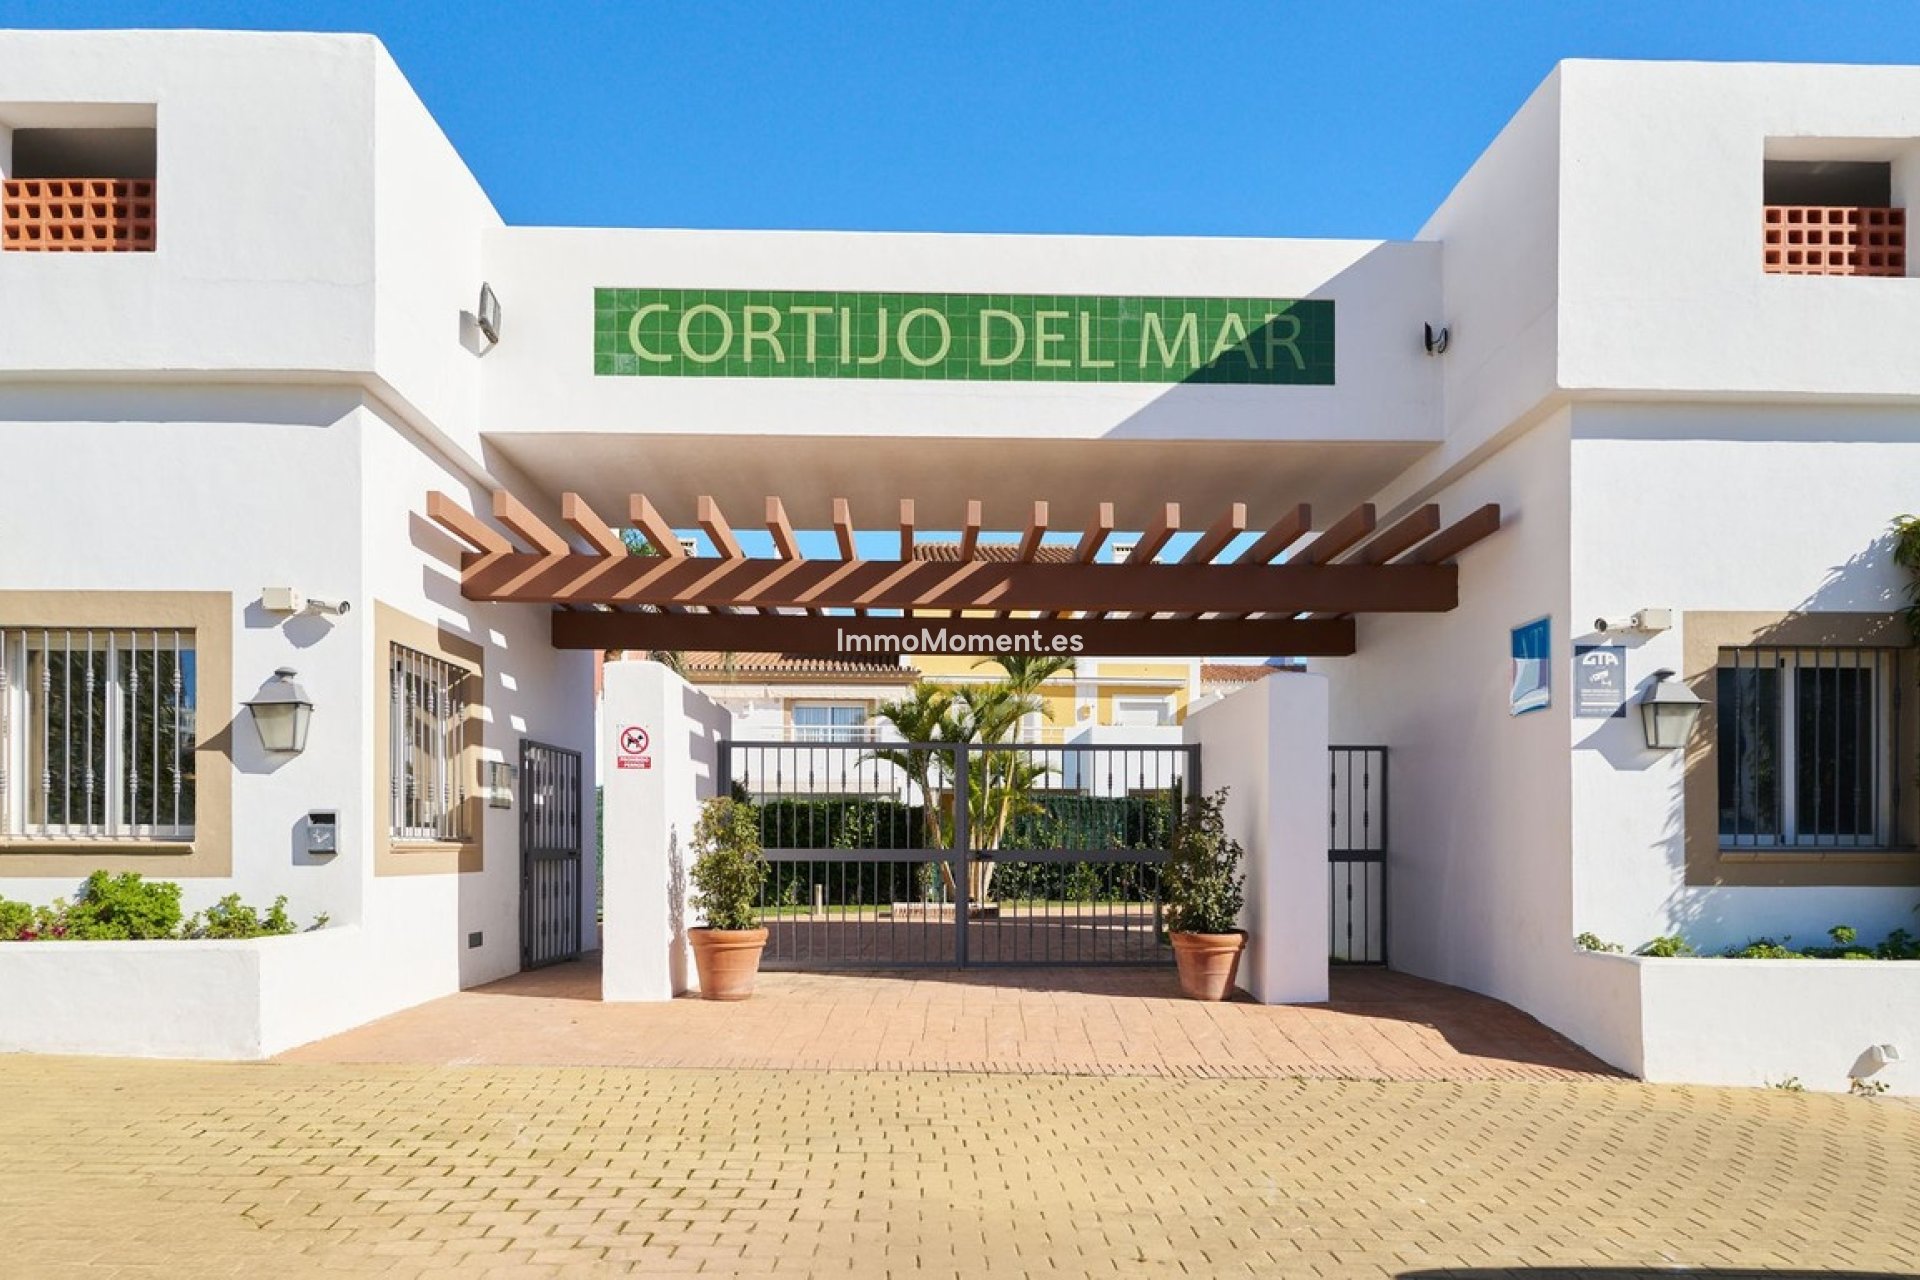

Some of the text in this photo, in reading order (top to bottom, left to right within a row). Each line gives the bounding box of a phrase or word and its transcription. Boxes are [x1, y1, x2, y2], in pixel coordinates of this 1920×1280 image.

[629, 304, 1306, 370] CORTIJO DEL MAR
